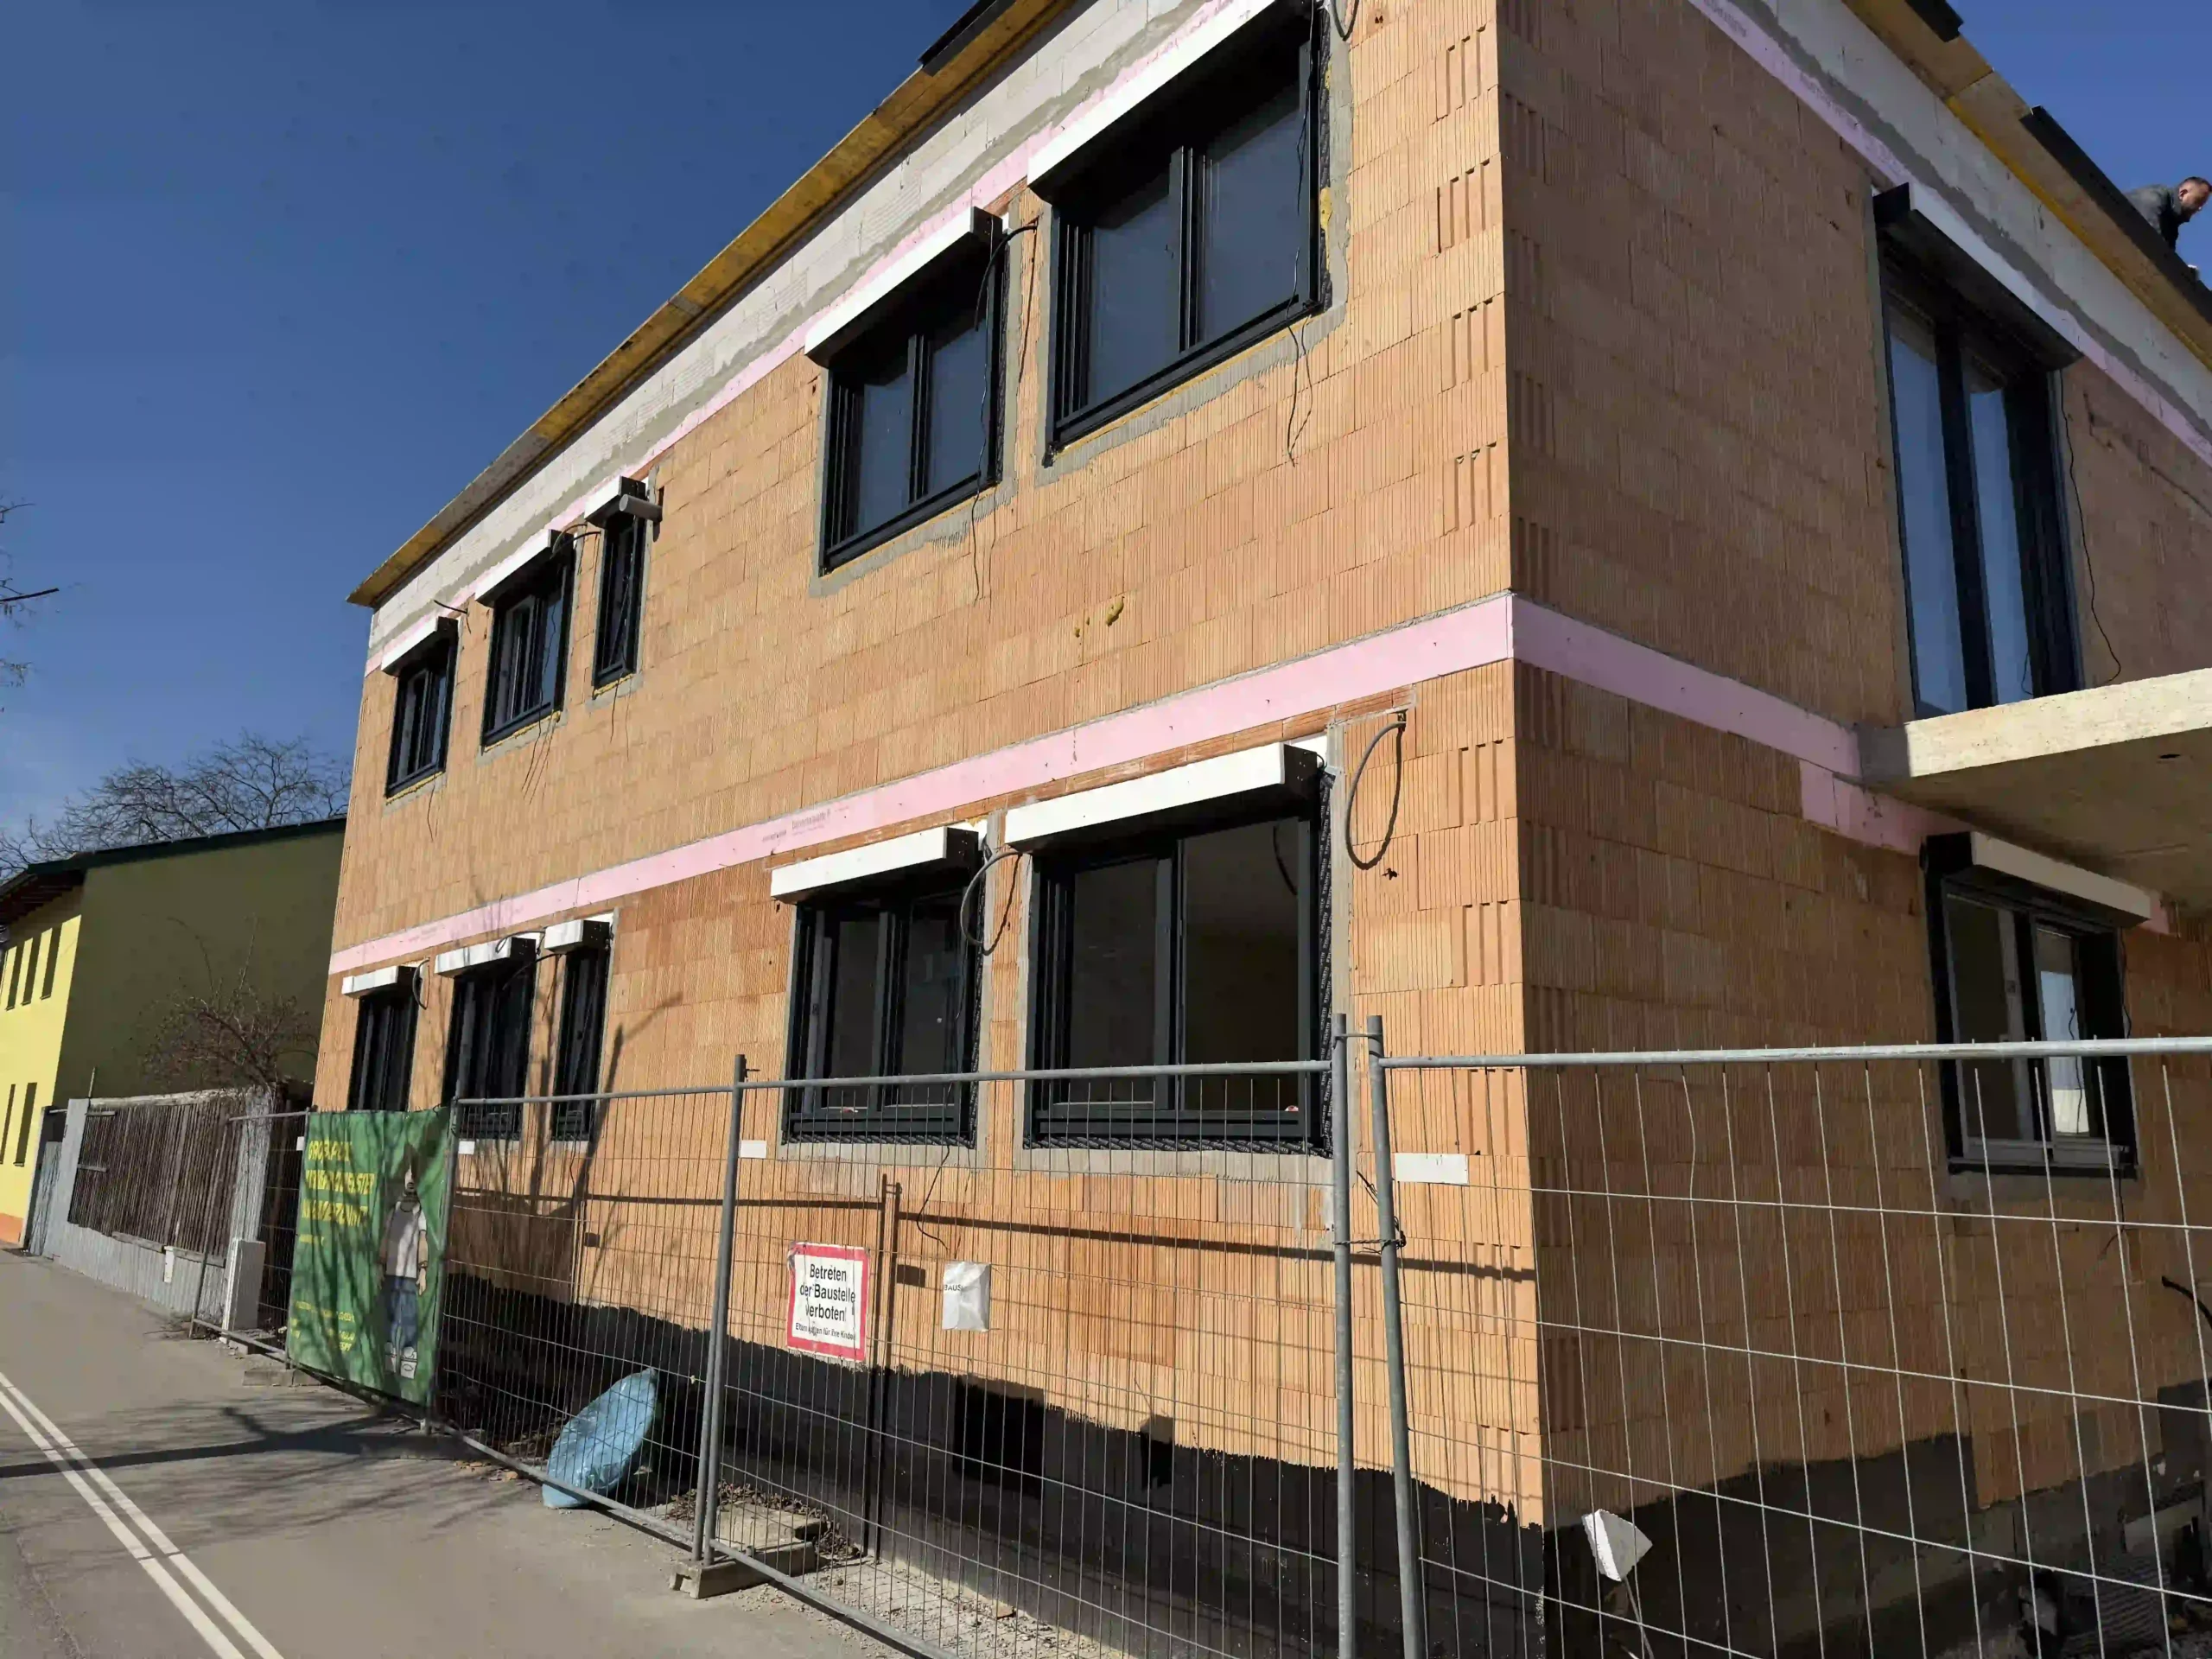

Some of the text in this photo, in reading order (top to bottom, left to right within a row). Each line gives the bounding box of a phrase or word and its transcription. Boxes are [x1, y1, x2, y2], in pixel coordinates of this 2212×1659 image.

[810, 1263, 847, 1282] Betreten
[799, 1281, 856, 1303] der Baustelle
